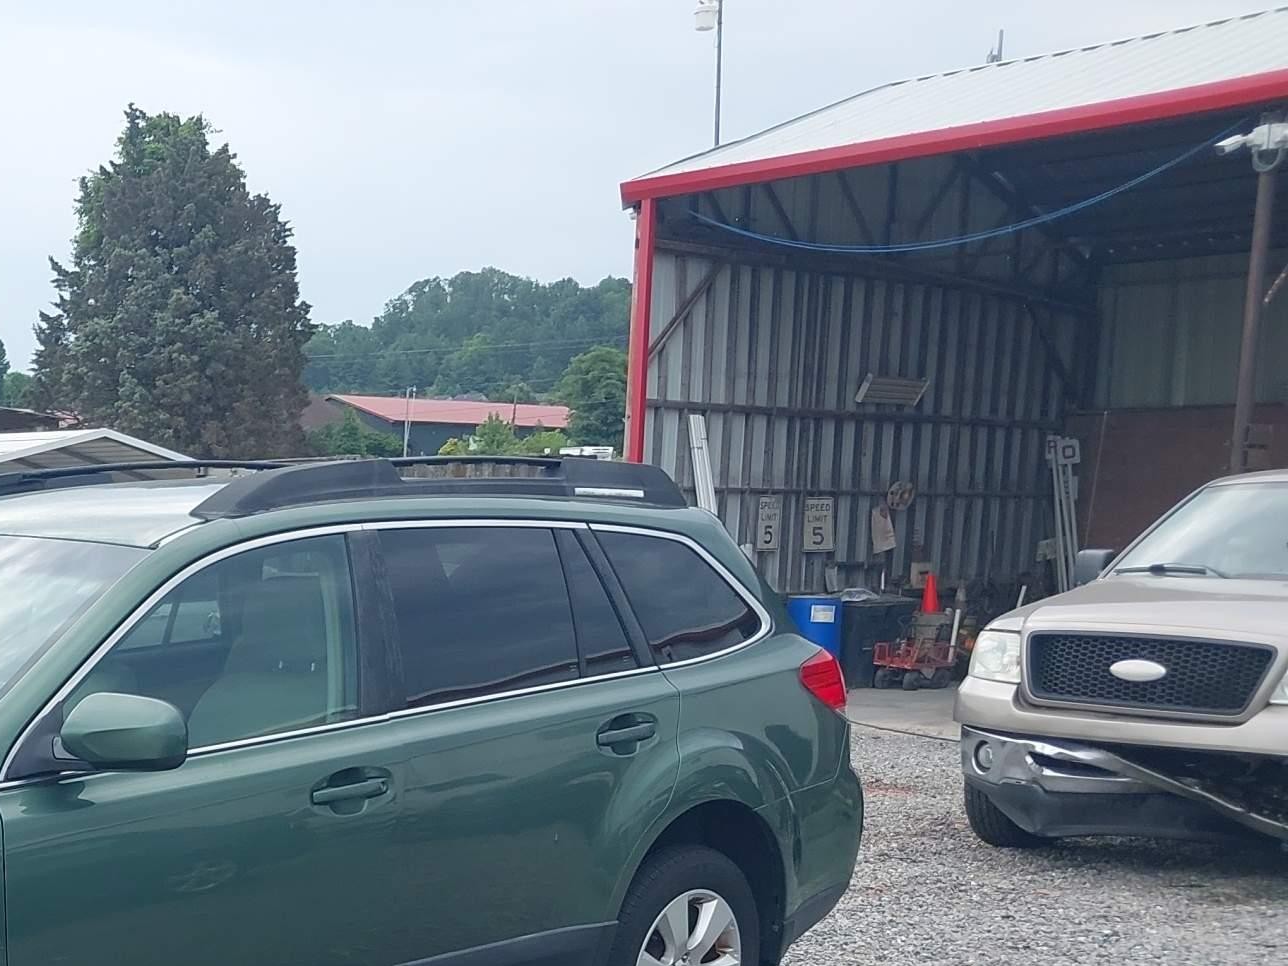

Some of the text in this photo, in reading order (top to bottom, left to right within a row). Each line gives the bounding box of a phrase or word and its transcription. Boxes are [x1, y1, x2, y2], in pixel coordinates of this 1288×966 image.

[805, 503, 830, 512] SPEED
[808, 513, 828, 523] LIMIT
[764, 525, 773, 544] 5
[812, 527, 824, 545] 5
